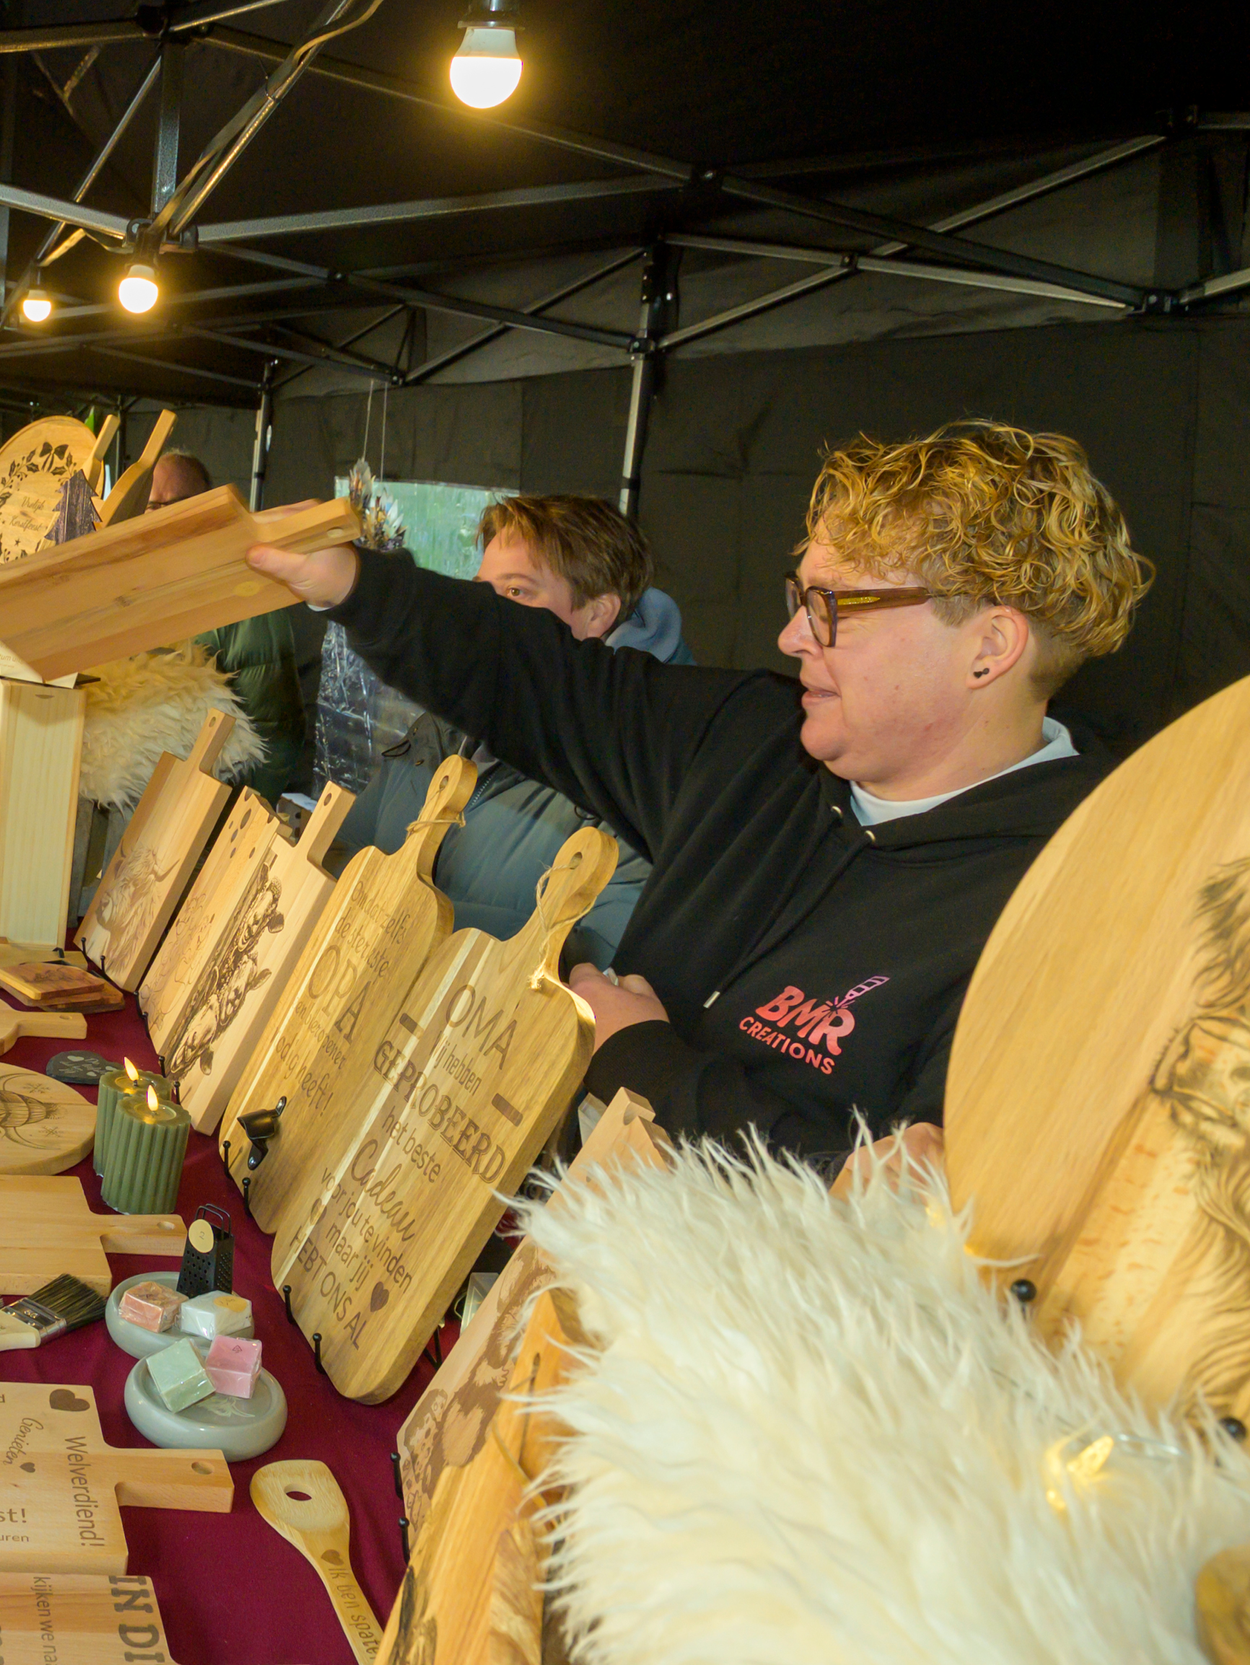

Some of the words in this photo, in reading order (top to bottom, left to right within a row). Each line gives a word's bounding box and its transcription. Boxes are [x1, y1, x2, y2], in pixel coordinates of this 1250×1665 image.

[335, 907, 352, 939] de
[347, 924, 389, 979] sterkste
[351, 880, 385, 924] Omdat
[379, 909, 410, 945] zelfs
[308, 944, 371, 1046] OPA
[445, 984, 517, 1070] OMA
[755, 985, 855, 1056] BMR
[443, 1044, 482, 1096] hebben
[739, 1016, 836, 1075] CREATIONS
[299, 1063, 334, 1117] heeft!
[373, 1040, 506, 1184] GEPROBEERD
[382, 1105, 407, 1145] het
[402, 1128, 441, 1183] beste
[351, 1139, 415, 1242] Cadeau
[321, 1167, 347, 1204] voor
[338, 1192, 363, 1227] jou
[360, 1215, 374, 1243] te
[372, 1236, 412, 1294] vinden
[325, 1222, 359, 1268] maar
[349, 1256, 374, 1291] jij
[289, 1225, 327, 1281] HEBT
[320, 1271, 352, 1322] ONS
[344, 1311, 367, 1350] AL
[3, 1417, 44, 1466] Genieten
[65, 1436, 105, 1547] Welverdiend!
[29, 1576, 54, 1617] kijken
[108, 1575, 154, 1614] IN
[328, 1568, 349, 1579] Ik
[337, 1585, 360, 1609] ben
[39, 1621, 55, 1642] we
